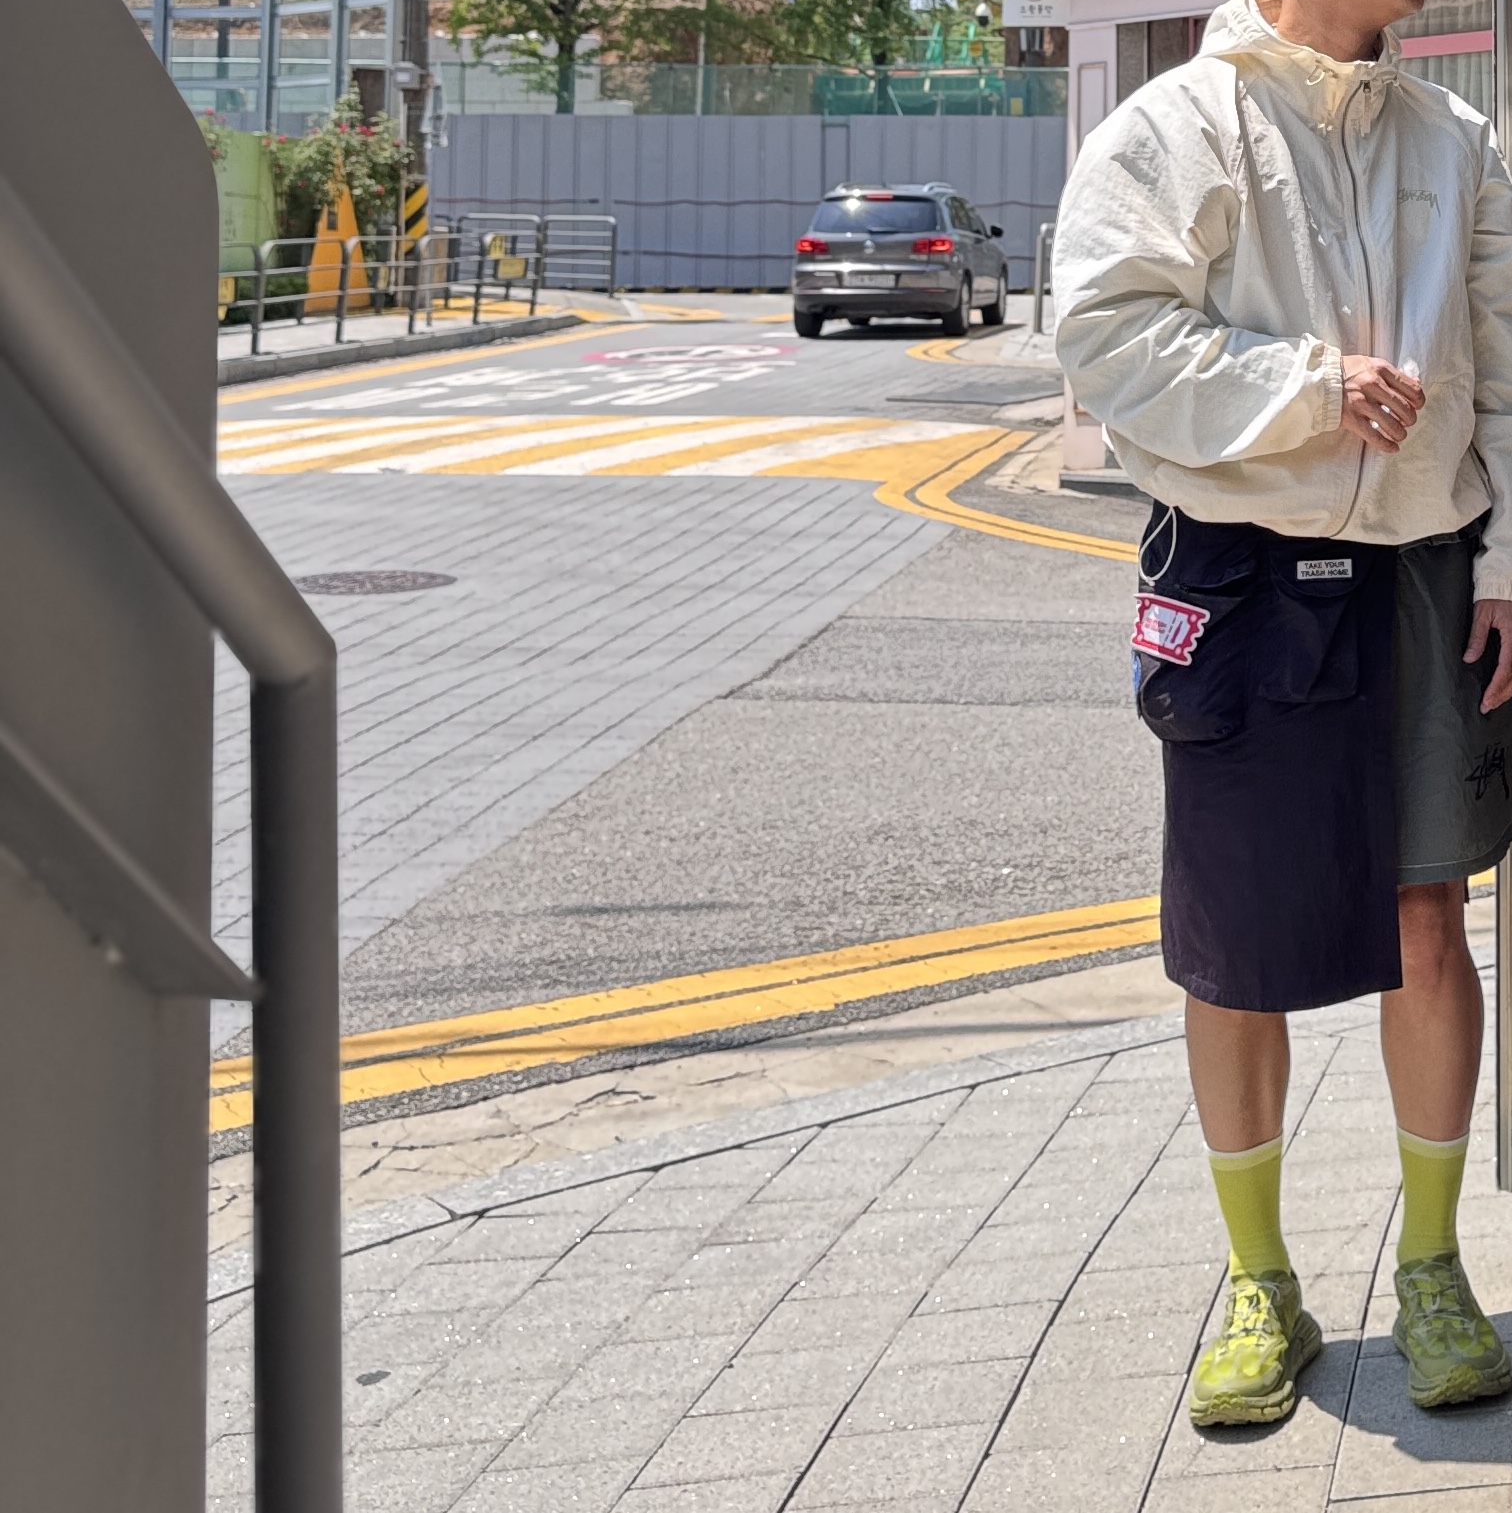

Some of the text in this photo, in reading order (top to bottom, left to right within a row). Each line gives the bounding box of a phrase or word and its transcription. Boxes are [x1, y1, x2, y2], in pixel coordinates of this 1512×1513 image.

[1304, 561, 1345, 570] TAKE YOUR
[1301, 569, 1349, 578] TRASH HOME
